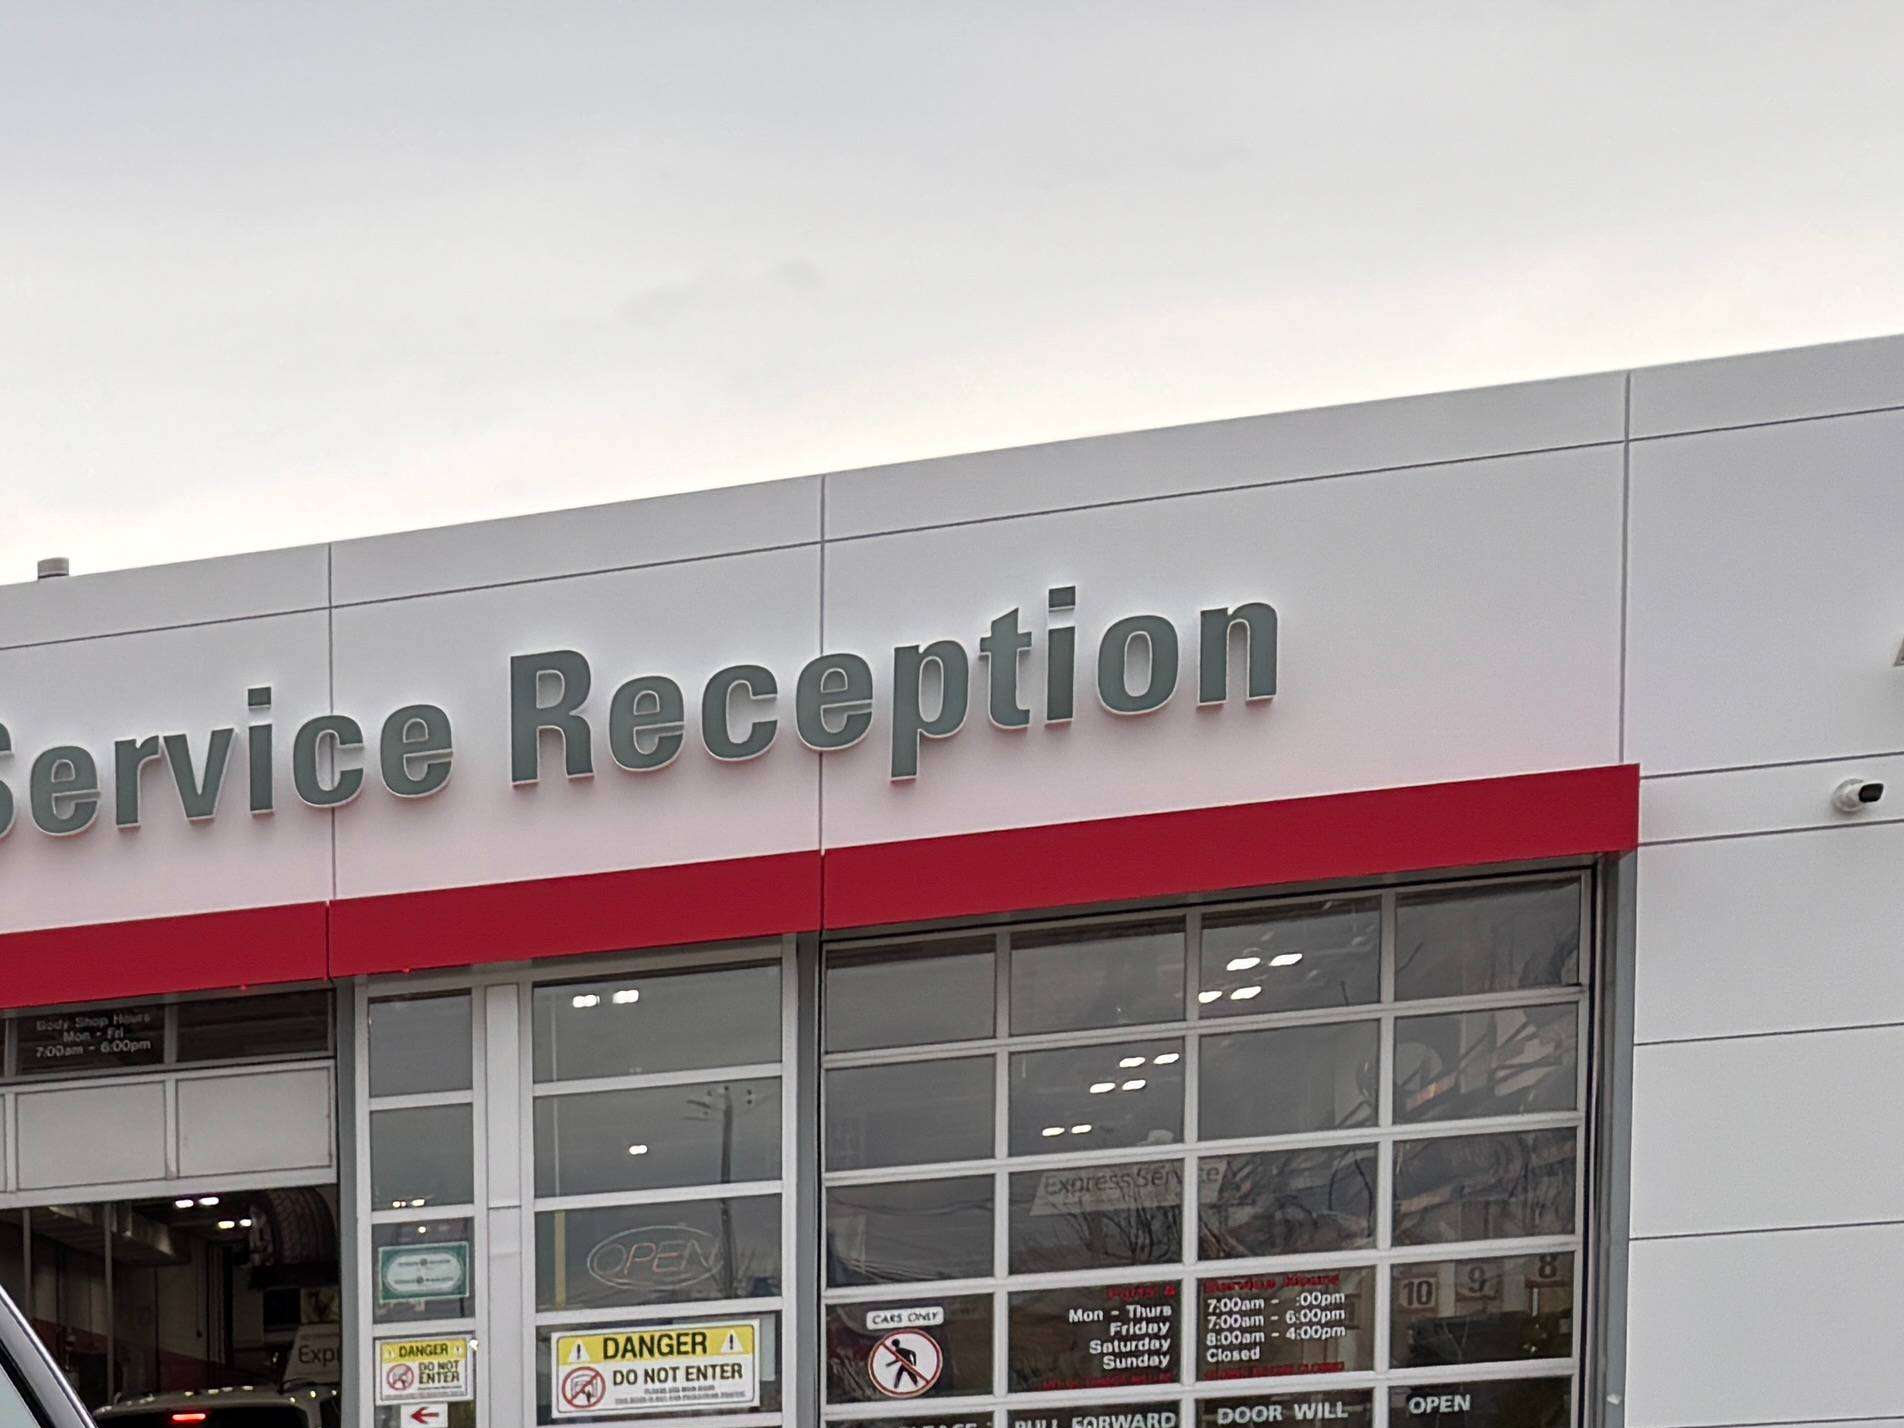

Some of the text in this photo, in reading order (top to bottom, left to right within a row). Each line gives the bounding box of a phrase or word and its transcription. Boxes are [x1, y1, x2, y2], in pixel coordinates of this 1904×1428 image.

[509, 585, 1278, 786] Reception
[1043, 1170, 1134, 1197] Express
[593, 1238, 720, 1276] OPEN
[1402, 1279, 1434, 1307] 10
[1068, 1308, 1104, 1323] Mon
[1126, 1304, 1172, 1319] Thurs
[1207, 1297, 1265, 1313] 7:00am
[872, 1311, 938, 1325] CARS ONLY
[1207, 1313, 1265, 1330] 7:00am
[1285, 1308, 1345, 1324] 6:00pm
[1109, 1320, 1171, 1336] Friday
[1206, 1331, 1265, 1346] 8:00am
[1285, 1325, 1346, 1341] 4:00pm
[398, 1343, 449, 1358] DANGER
[602, 1331, 708, 1360] DANGER
[1089, 1337, 1172, 1354] Saturday
[1206, 1346, 1261, 1363] Closed
[418, 1359, 460, 1372] DO NOT
[1103, 1353, 1171, 1370] Sunday
[418, 1371, 460, 1385] ENTER
[612, 1362, 744, 1387] DO NOT ENTER
[1216, 1404, 1283, 1426] DOOR
[1293, 1401, 1349, 1420] WILL
[1408, 1393, 1471, 1415] OPEN
